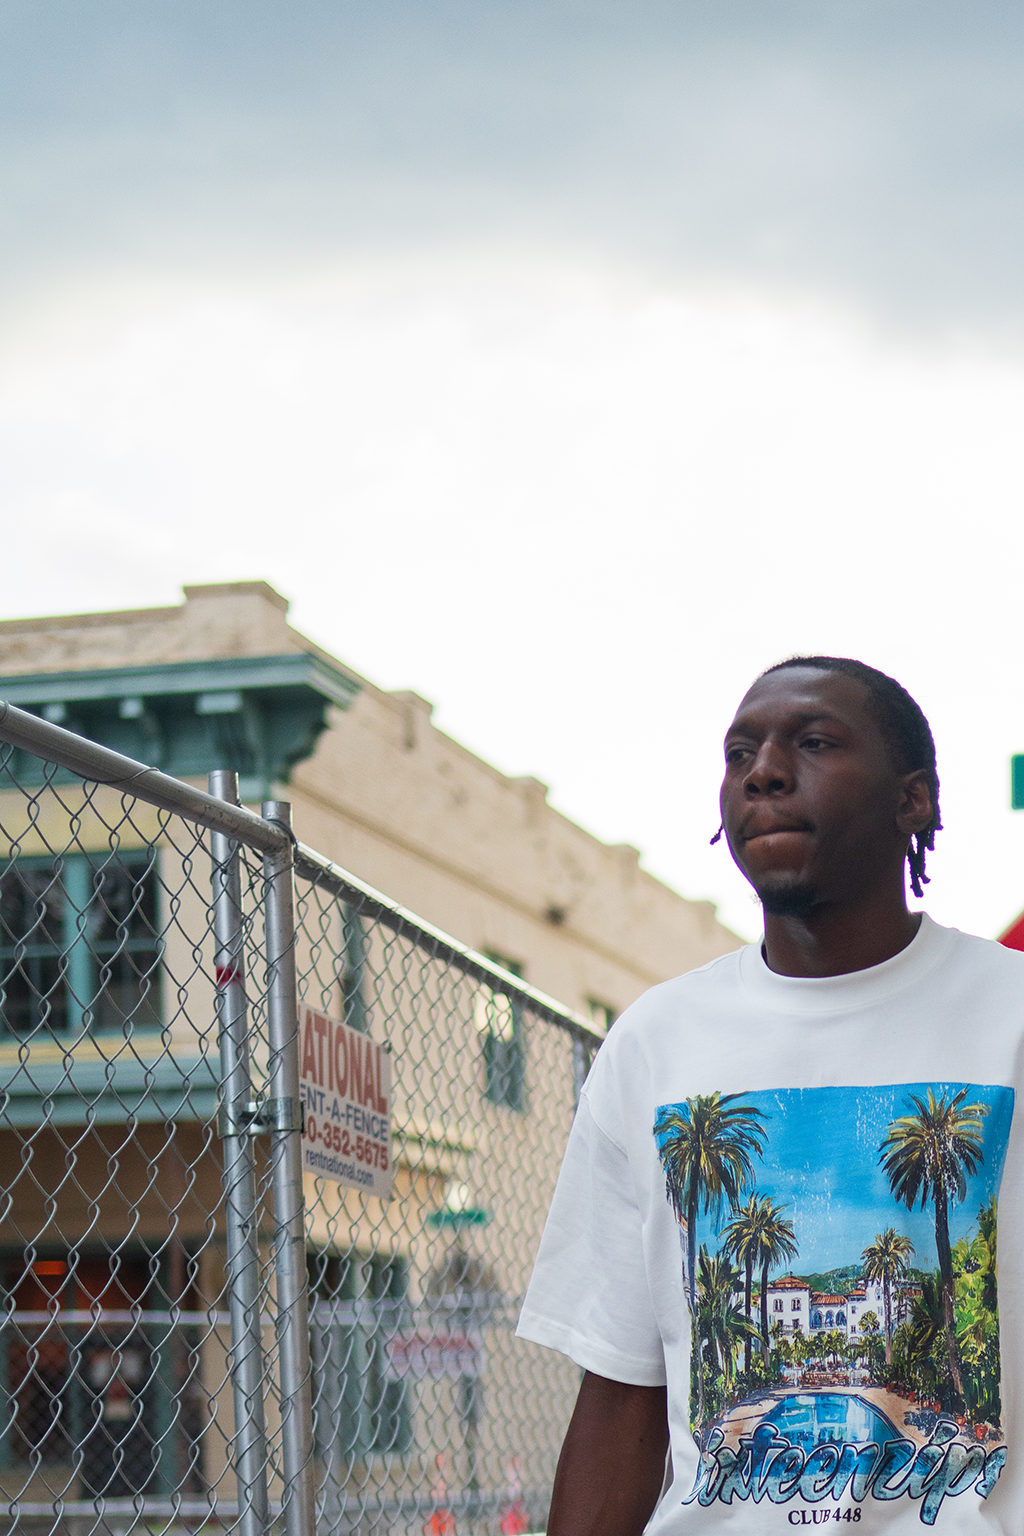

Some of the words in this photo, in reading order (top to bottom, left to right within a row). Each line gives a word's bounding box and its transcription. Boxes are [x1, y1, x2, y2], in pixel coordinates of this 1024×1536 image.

[299, 1007, 388, 1115] ATIONAL
[301, 1083, 388, 1142] NT-A-FENCE
[302, 1115, 389, 1171] 0-352-5675
[306, 1150, 375, 1187] rentnational.com
